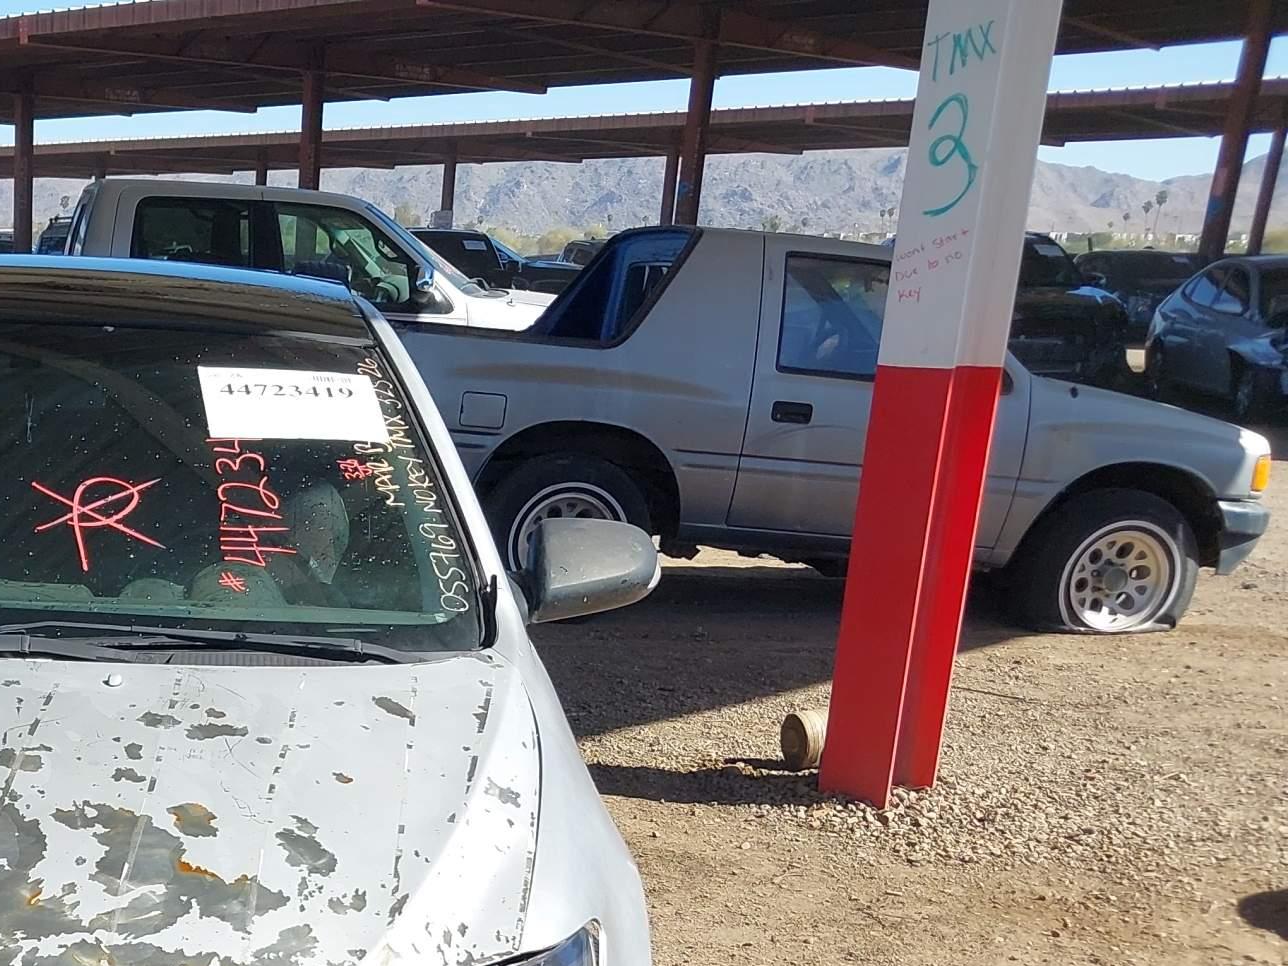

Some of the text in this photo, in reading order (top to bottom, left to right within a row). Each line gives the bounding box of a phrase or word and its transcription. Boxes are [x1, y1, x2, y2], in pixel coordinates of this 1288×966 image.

[928, 20, 996, 81] TMX
[922, 93, 977, 216] 3
[220, 383, 353, 399] 44723419
